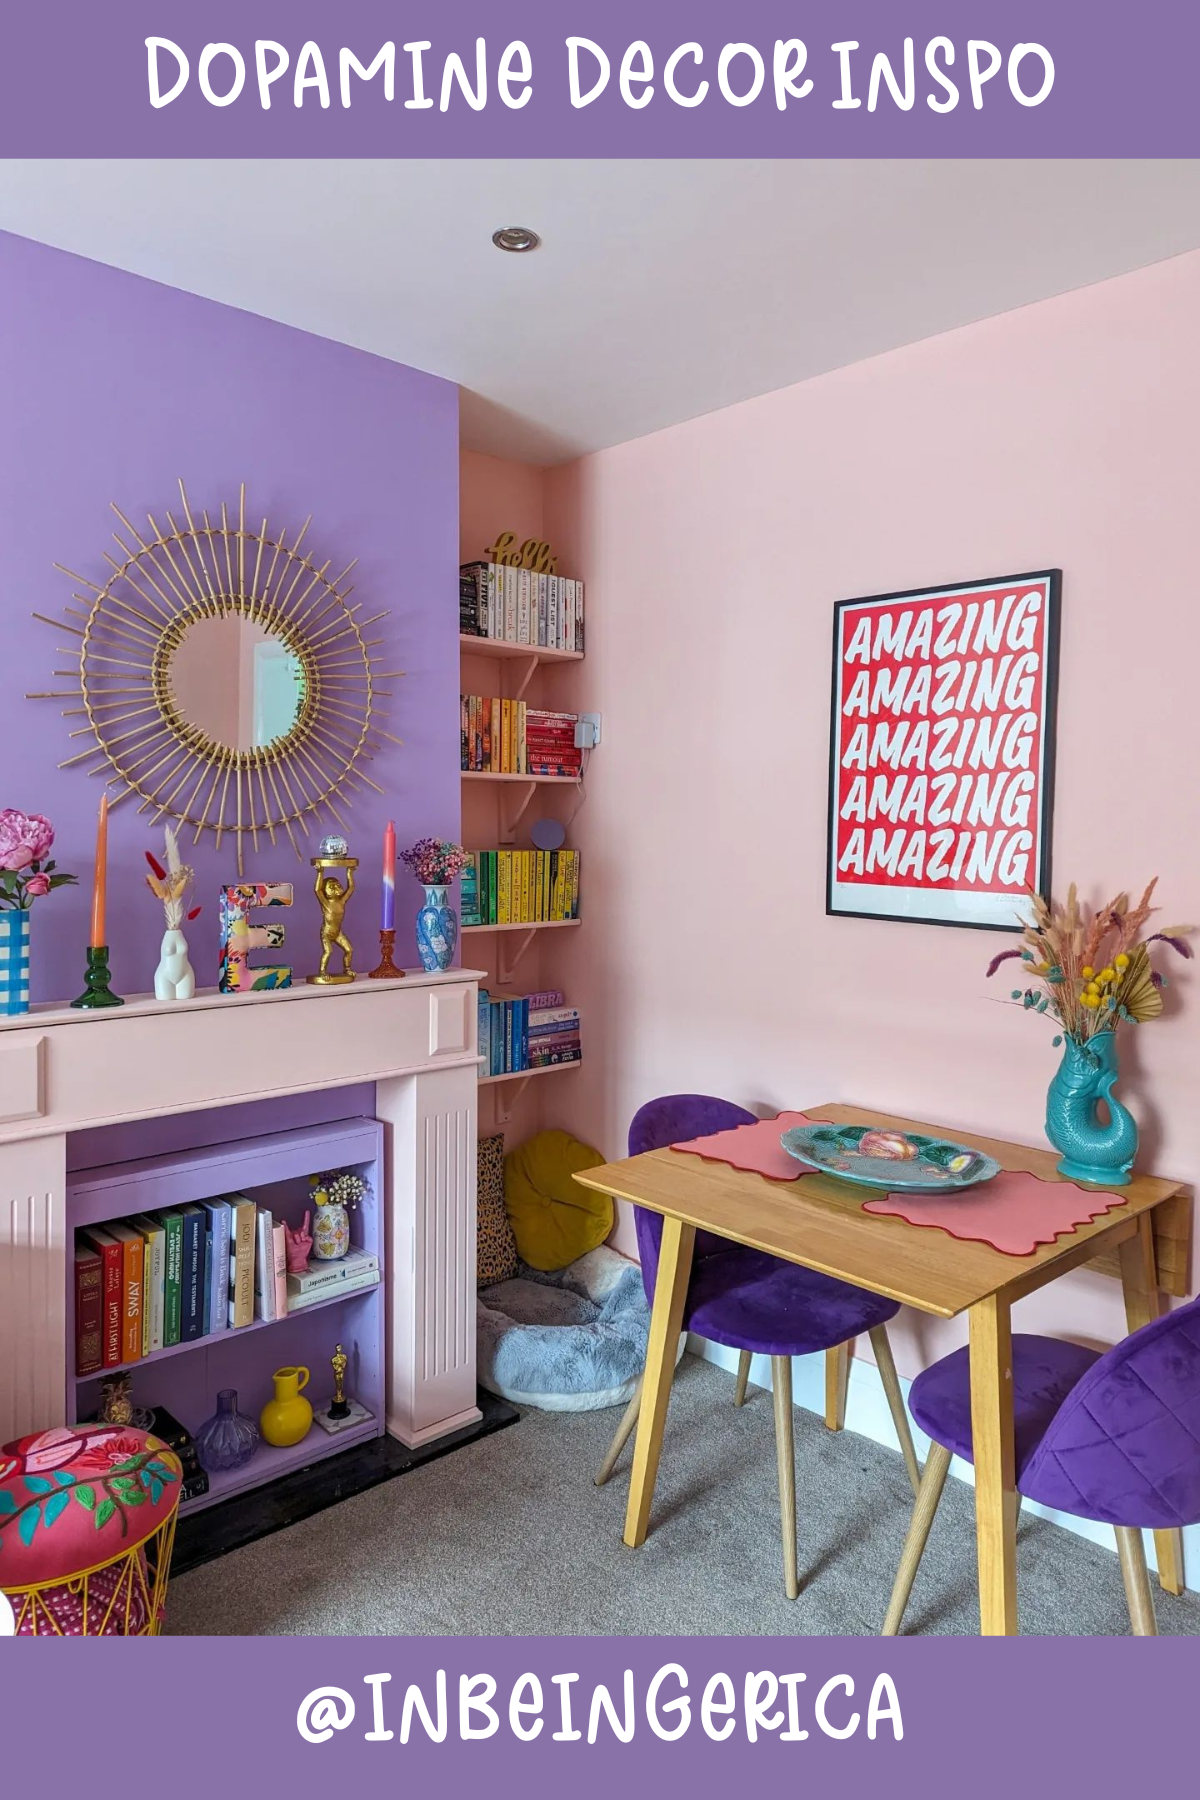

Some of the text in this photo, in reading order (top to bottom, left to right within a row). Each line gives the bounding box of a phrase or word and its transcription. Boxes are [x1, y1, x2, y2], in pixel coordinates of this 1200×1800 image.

[844, 591, 1042, 665] AMAZING
[843, 652, 1039, 718] AMAZING
[841, 712, 1038, 772] AMAZING
[840, 771, 1035, 827] AMAZING
[838, 828, 1033, 886] AMAZING
[529, 993, 563, 1008] LIBRA
[532, 1046, 550, 1057] skin
[242, 1223, 250, 1243] JODI
[241, 1268, 249, 1306] PICOULT
[308, 1273, 337, 1287] Japonisme
[109, 1302, 118, 1328] LIGHT
[128, 1281, 140, 1317] SWAY
[109, 1329, 118, 1352] FIRST
